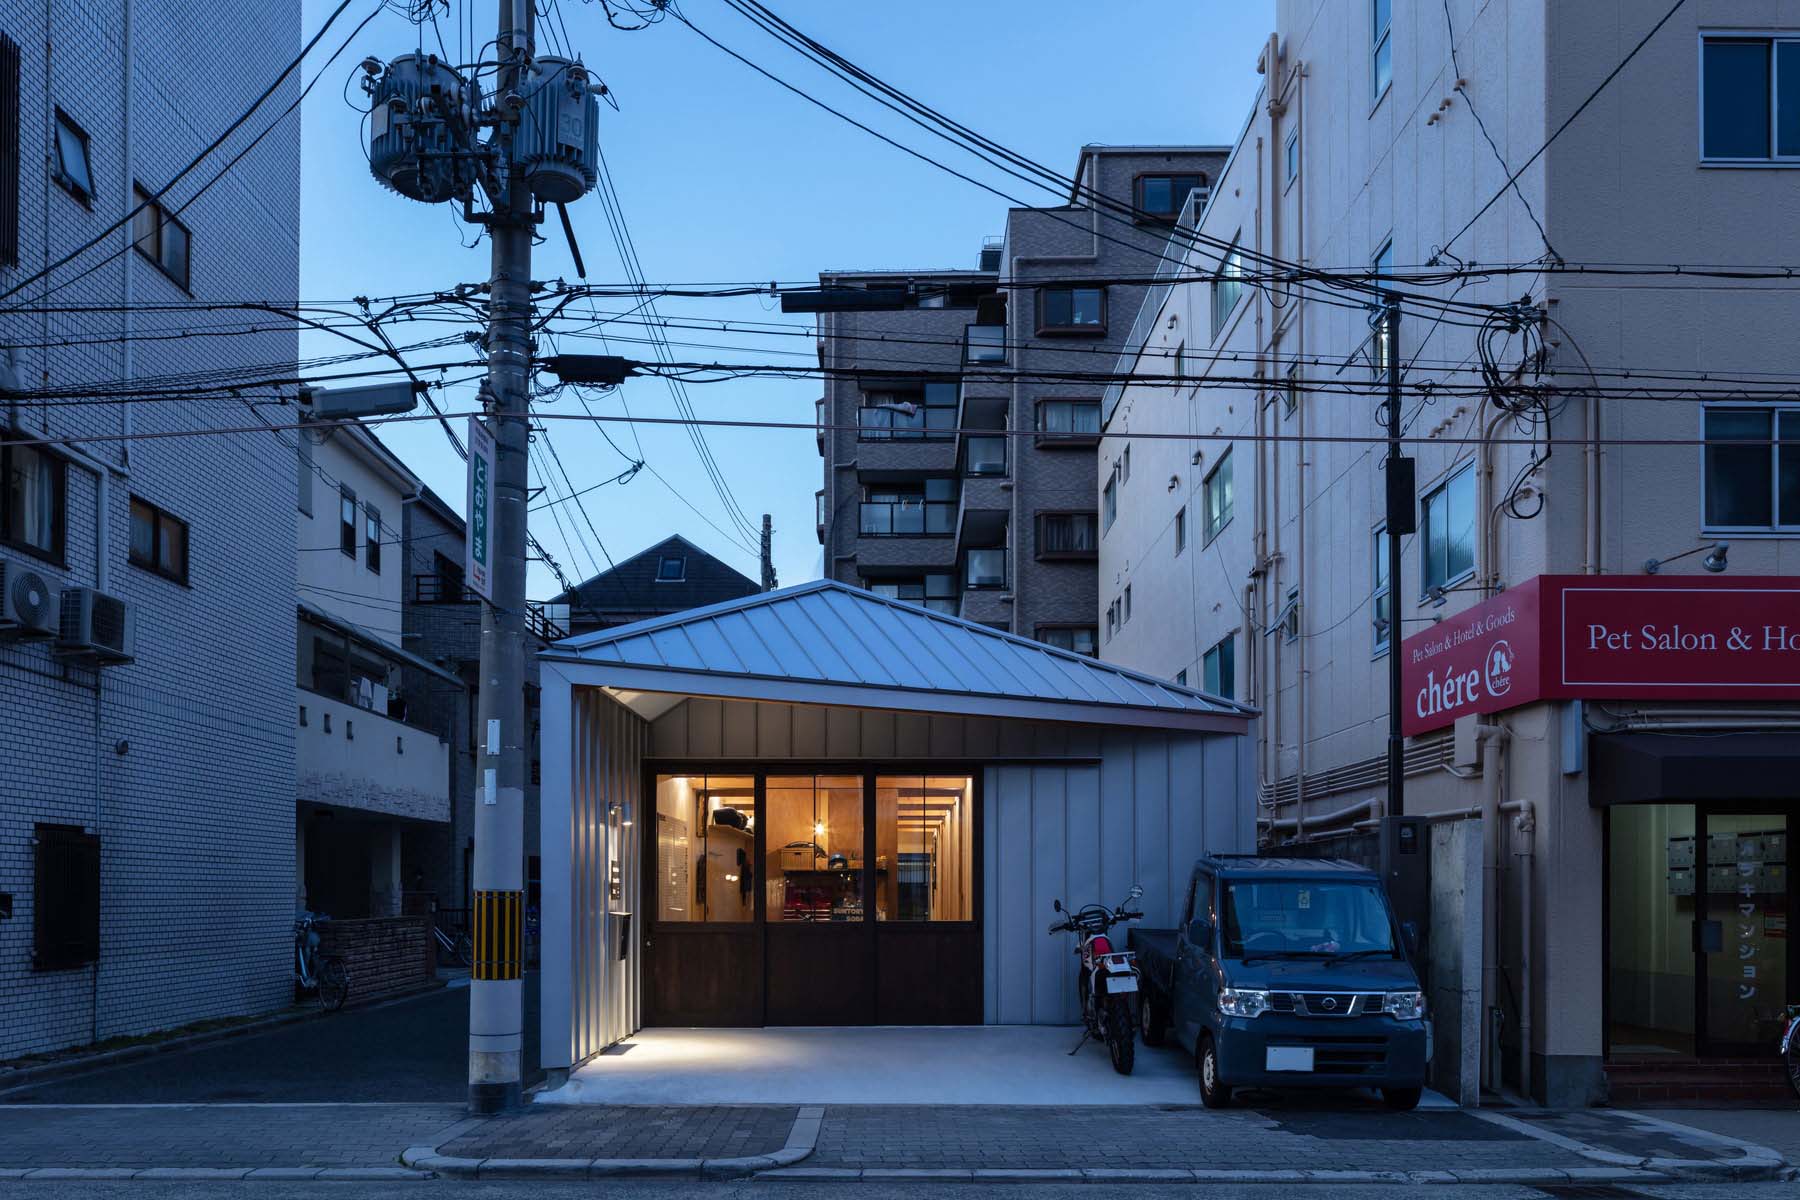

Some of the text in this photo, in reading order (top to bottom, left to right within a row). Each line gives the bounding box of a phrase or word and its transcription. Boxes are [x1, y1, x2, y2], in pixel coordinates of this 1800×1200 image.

[474, 457, 485, 560] とおやま
[1412, 606, 1515, 664] Pet Salon & Hotel & Goods
[1587, 624, 1633, 650] Pet
[1641, 624, 1717, 650] Salon
[1726, 626, 1752, 650] &
[1416, 665, 1480, 718] chére
